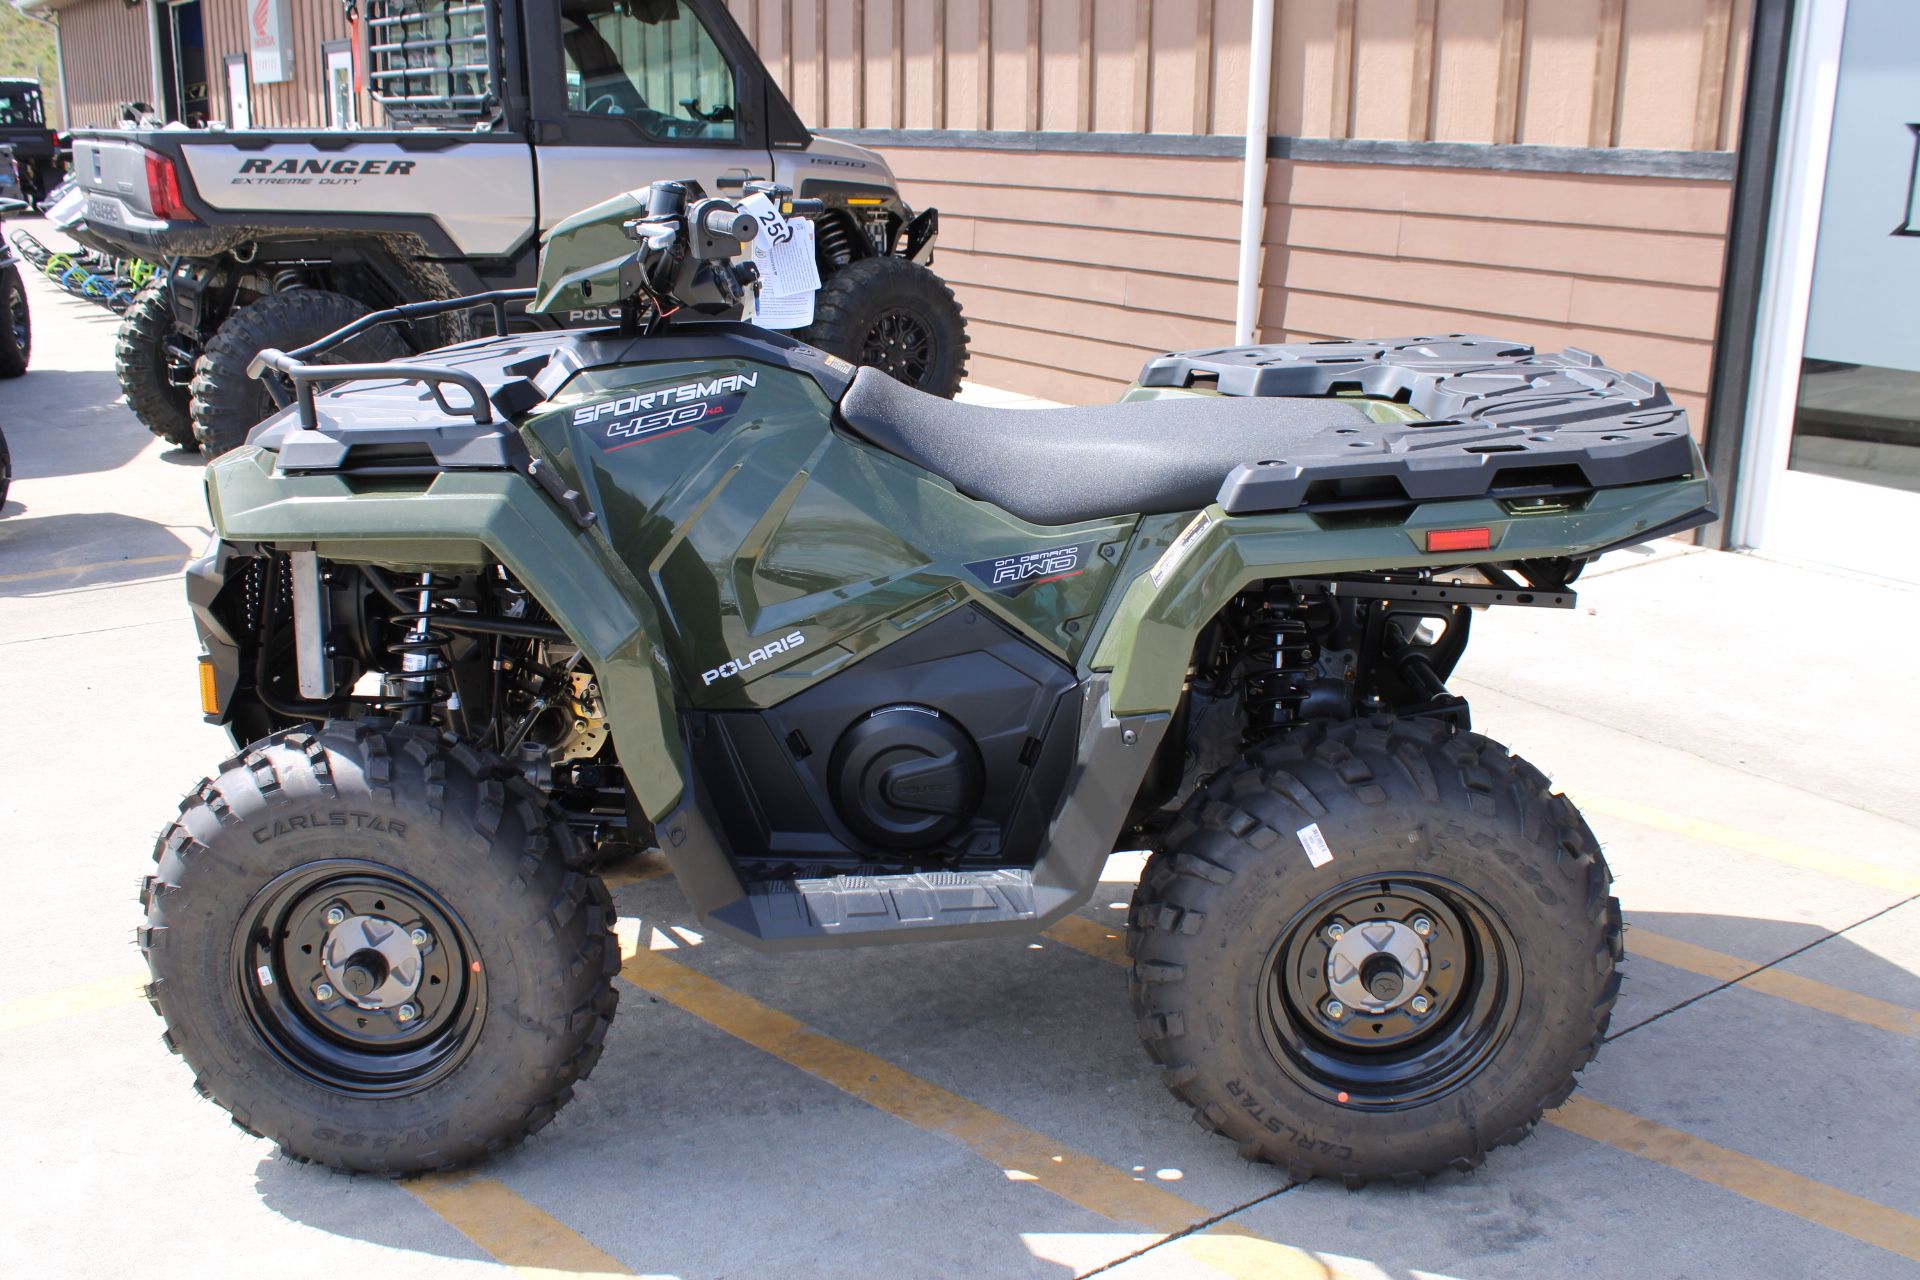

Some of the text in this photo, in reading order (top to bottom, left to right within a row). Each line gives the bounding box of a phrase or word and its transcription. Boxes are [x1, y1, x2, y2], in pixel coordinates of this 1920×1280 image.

[239, 158, 416, 175] RANGER
[810, 158, 866, 169] 1500
[231, 177, 314, 185] EXTREME
[572, 371, 758, 427] SPORTSMAN
[606, 402, 708, 438] 450
[993, 554, 1078, 584] AWD
[995, 547, 1078, 567] ON DEMAND
[701, 630, 805, 686] POLARIS
[252, 810, 408, 845] CARLSTAR
[1226, 1078, 1353, 1161] CARLSTAR
